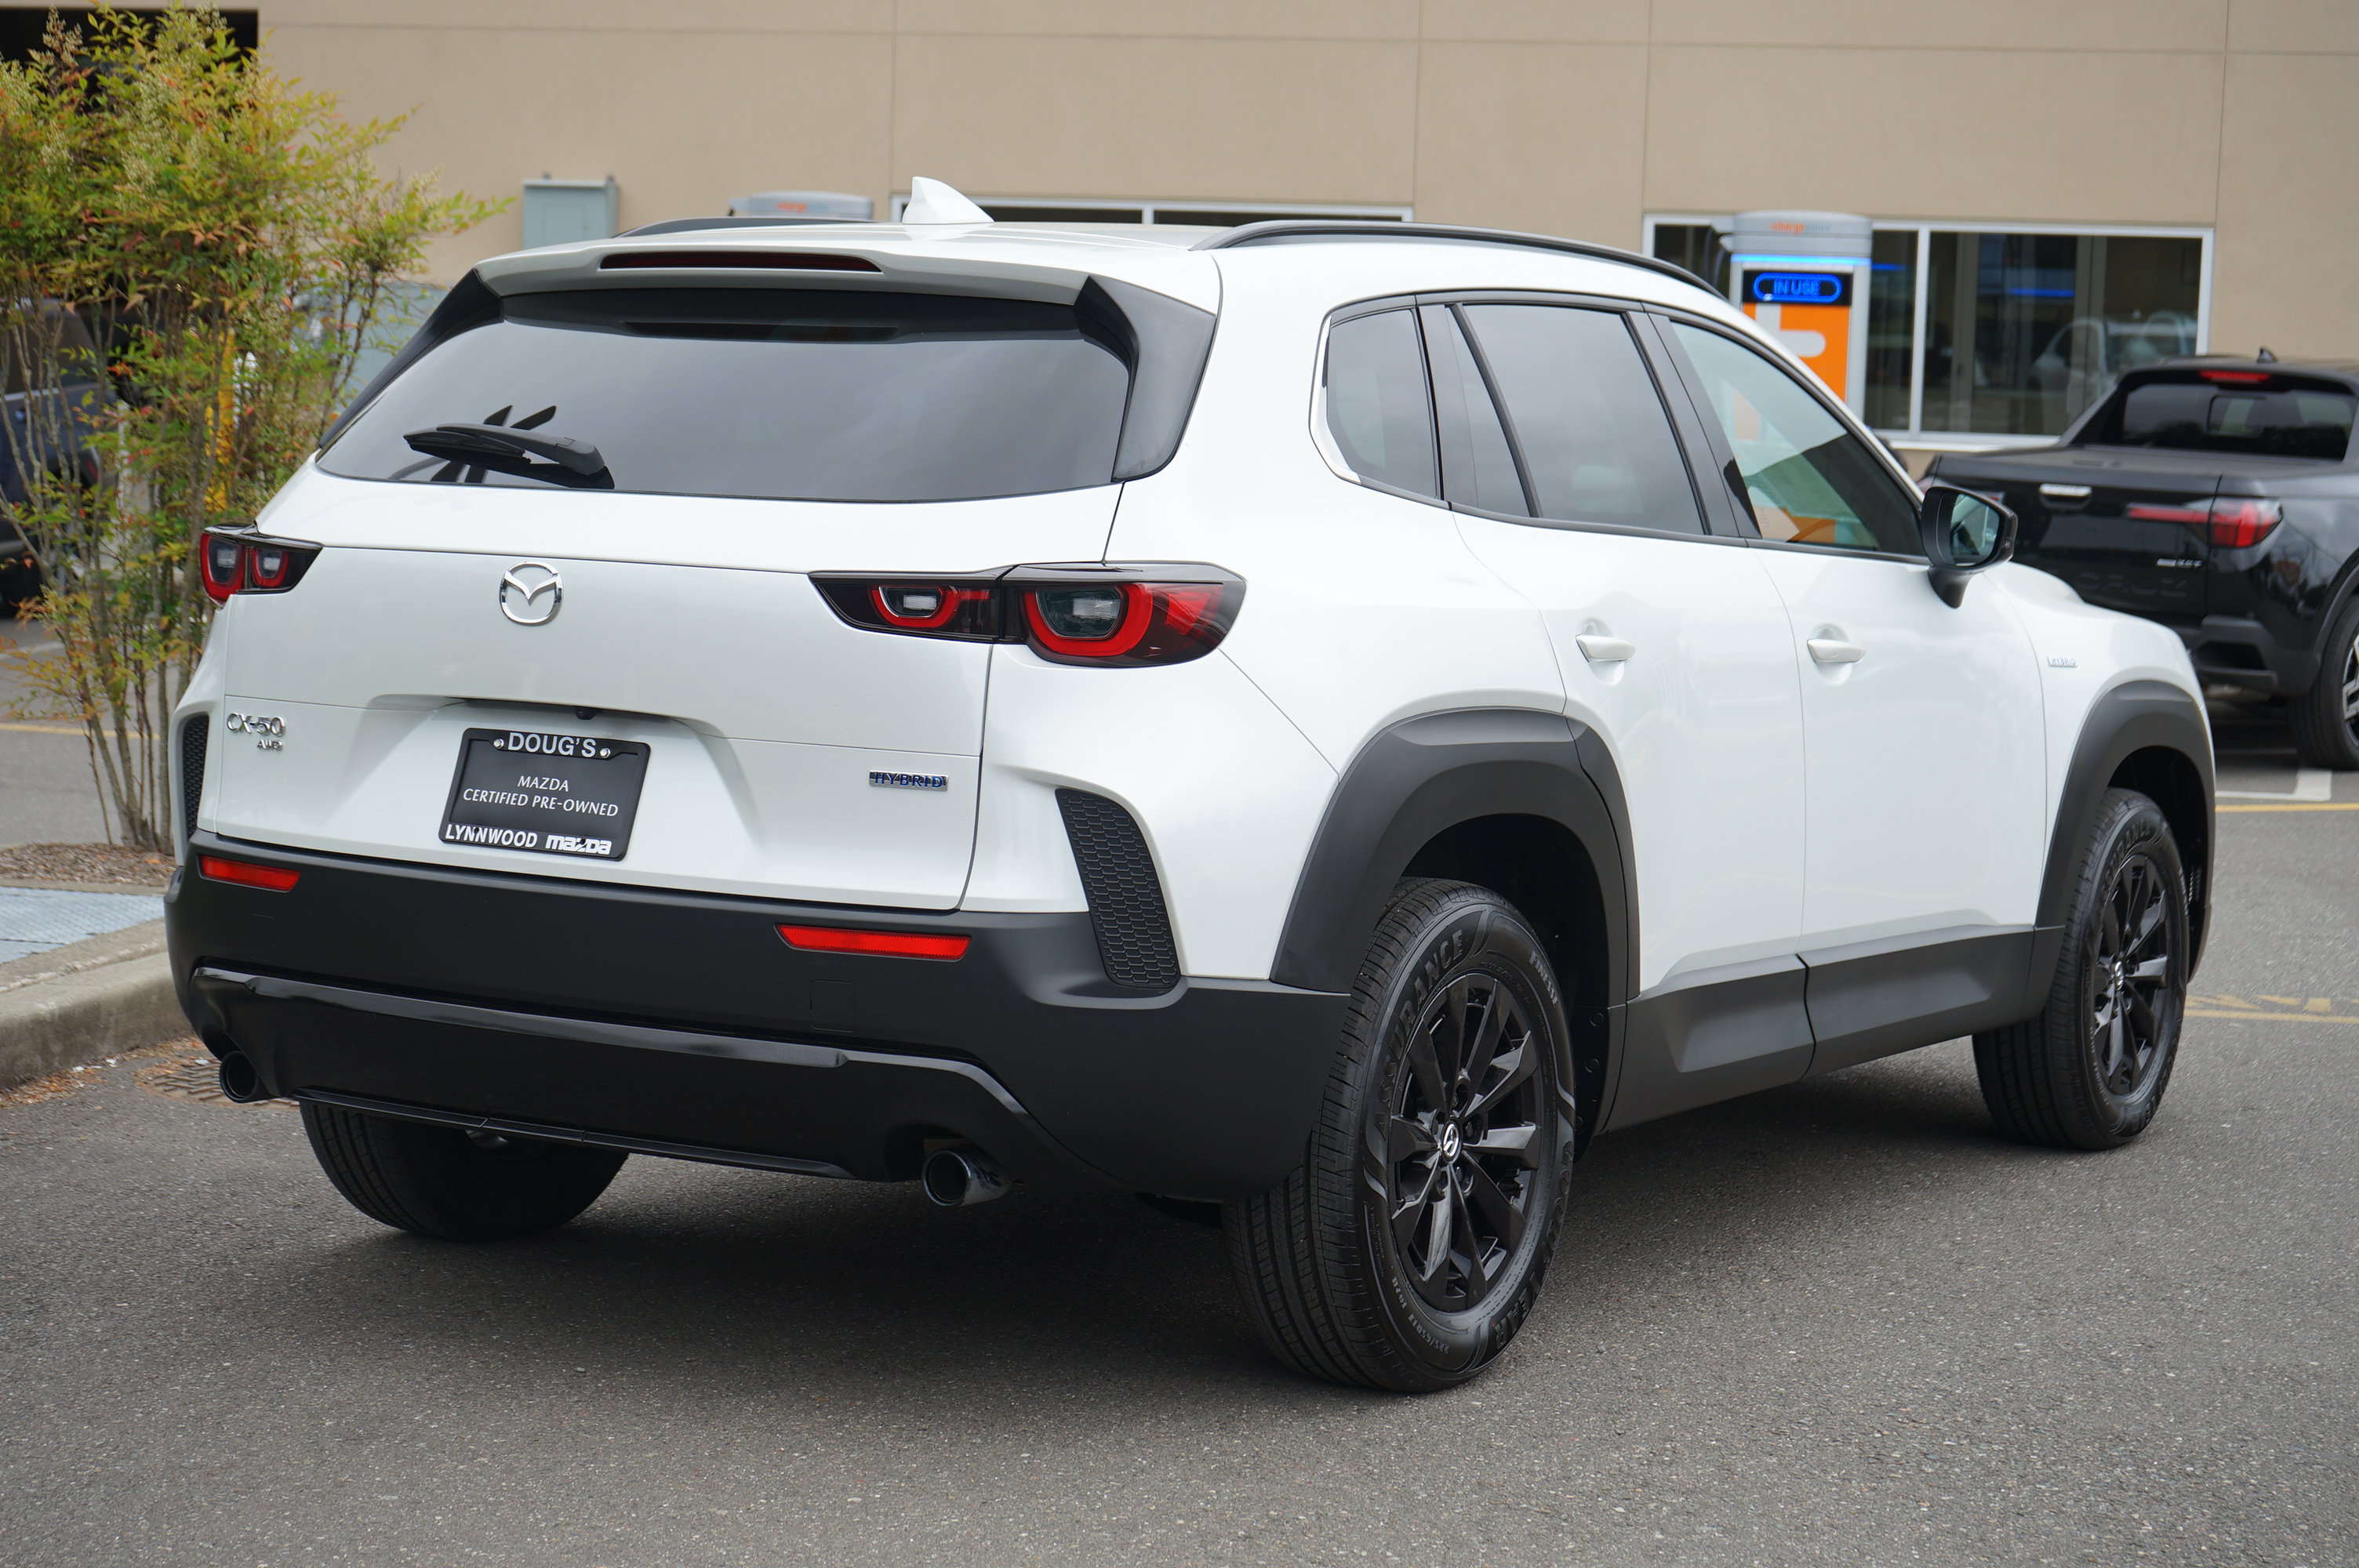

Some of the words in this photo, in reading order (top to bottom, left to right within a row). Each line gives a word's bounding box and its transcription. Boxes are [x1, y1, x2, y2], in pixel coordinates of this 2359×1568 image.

[1770, 223, 1832, 234] charge
[1774, 278, 1787, 295] IN
[1791, 279, 1819, 296] USE
[227, 712, 286, 738] CX-50
[507, 731, 597, 758] DOUG'S
[518, 775, 569, 792] MAZDA
[874, 771, 943, 788] HYBRID
[463, 788, 529, 807] CERTIFIED
[532, 796, 619, 818] PRE-OWNED
[445, 823, 538, 848] LYNNWOOD
